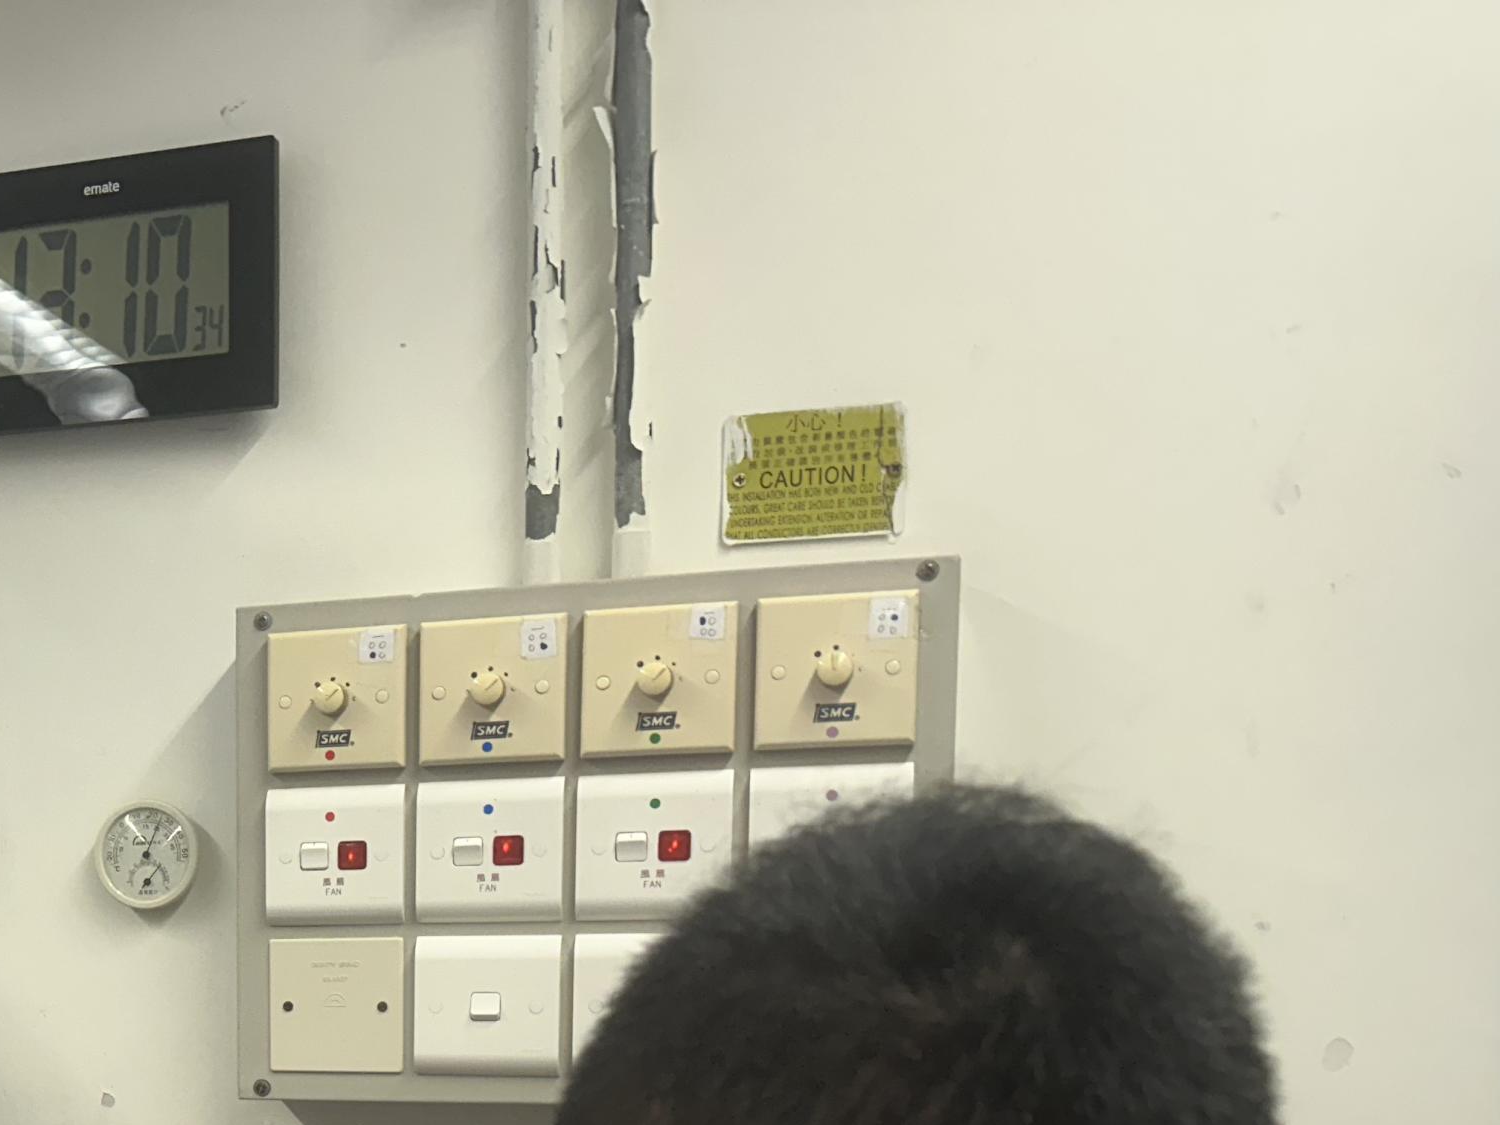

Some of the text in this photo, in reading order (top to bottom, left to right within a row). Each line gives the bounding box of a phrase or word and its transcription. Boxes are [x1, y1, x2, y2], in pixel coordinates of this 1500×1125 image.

[83, 181, 120, 195] emate
[818, 706, 853, 719] SMC
[641, 715, 674, 728] SMC
[476, 724, 506, 737] SMC
[319, 732, 349, 745] SMC
[479, 883, 497, 892] FAN
[643, 880, 662, 888] FAN
[325, 888, 342, 896] FAN
